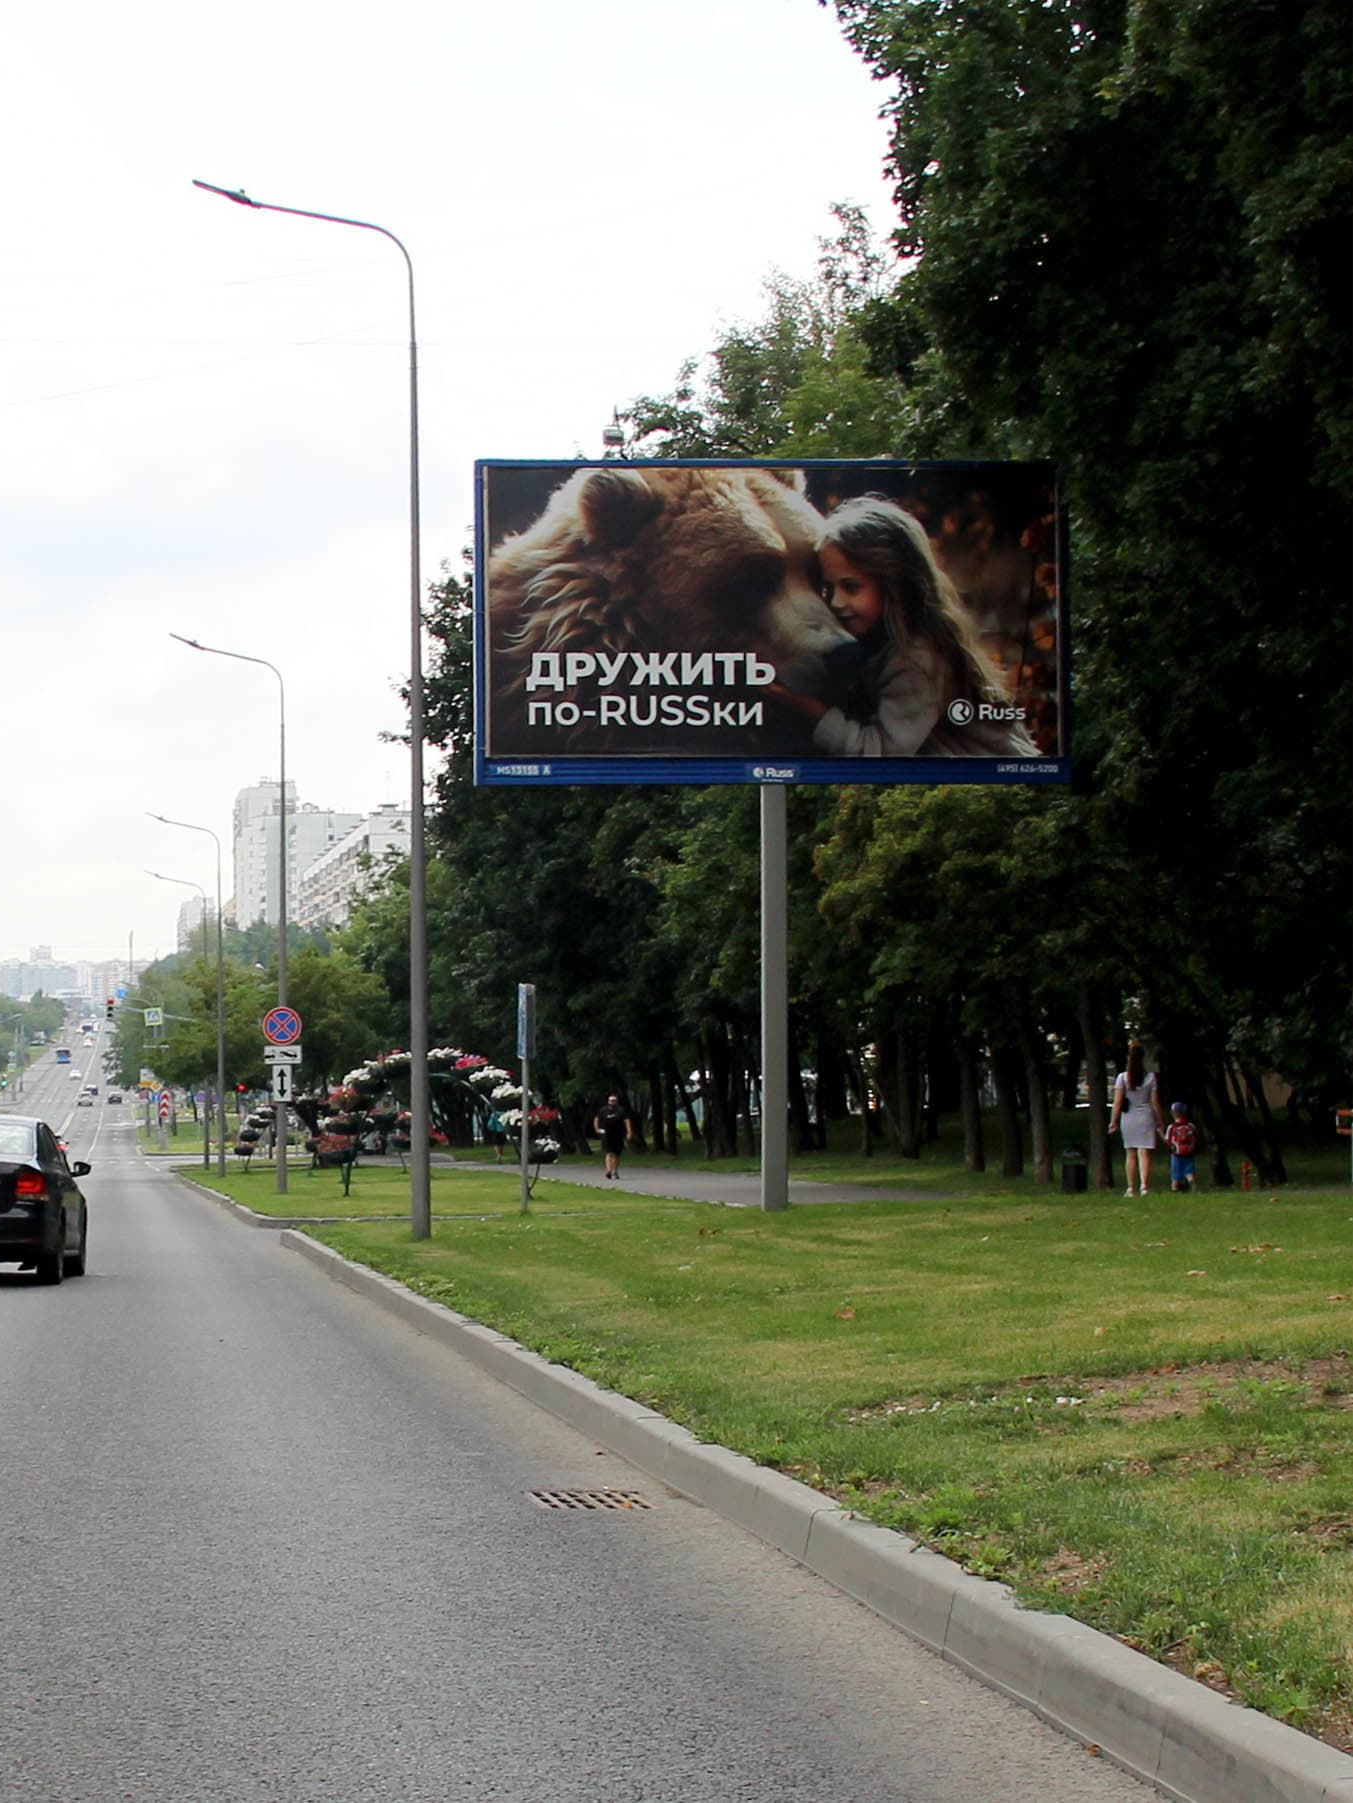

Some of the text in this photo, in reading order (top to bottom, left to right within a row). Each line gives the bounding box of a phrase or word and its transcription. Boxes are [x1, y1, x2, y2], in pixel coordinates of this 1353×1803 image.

[526, 652, 776, 691] ДРУЖИТЬ
[528, 695, 764, 726] по-RUSSки
[979, 704, 1026, 720] Russ
